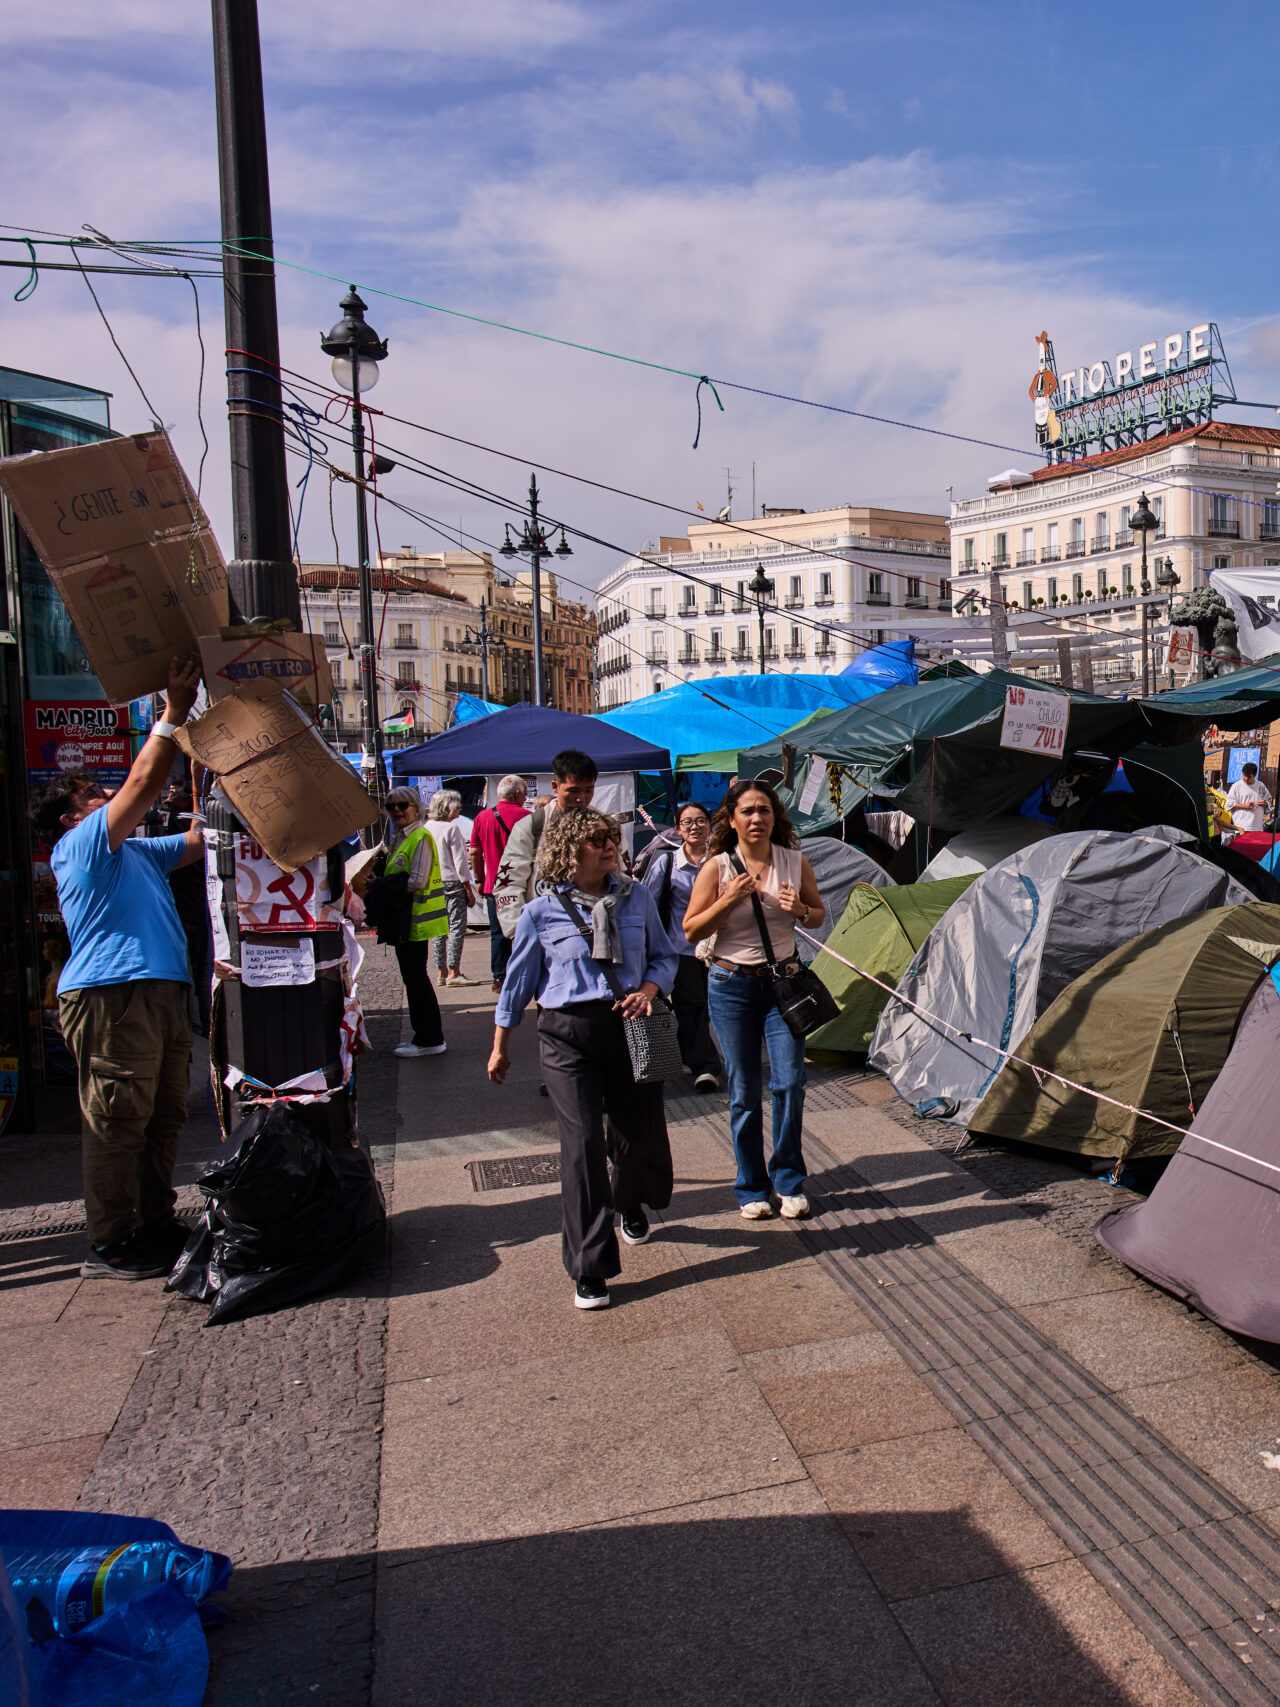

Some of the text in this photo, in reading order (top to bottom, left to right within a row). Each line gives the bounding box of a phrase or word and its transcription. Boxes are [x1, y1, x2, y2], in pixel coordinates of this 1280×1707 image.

[1060, 322, 1211, 402] TIO PEPE
[1157, 384, 1212, 419] BYASS
[130, 488, 150, 508] SIN
[245, 659, 304, 677] METRO
[1009, 687, 1025, 706] NO
[35, 707, 119, 730] MADRID
[64, 723, 115, 740] City Tour
[85, 754, 124, 763] BUY HERE
